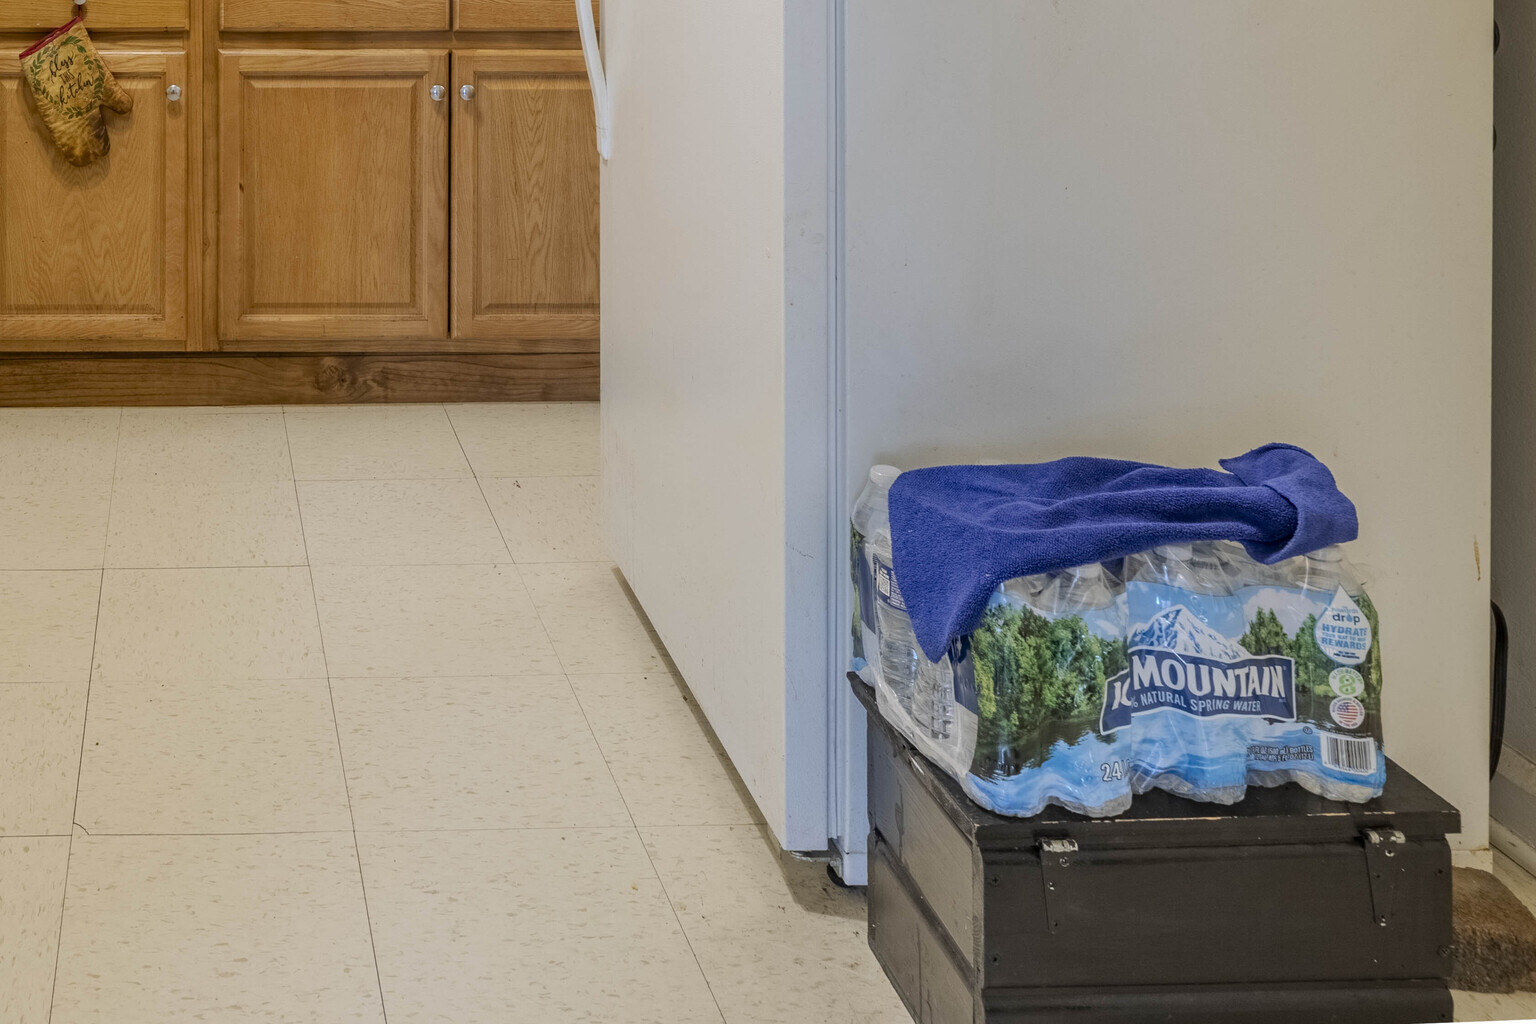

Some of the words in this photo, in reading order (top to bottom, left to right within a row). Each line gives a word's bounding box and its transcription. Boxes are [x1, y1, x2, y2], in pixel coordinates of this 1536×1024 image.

[49, 51, 75, 83] bless
[59, 69, 75, 84] THIS
[59, 72, 94, 106] kitchen
[1322, 623, 1368, 637] HYDRATE
[1321, 637, 1367, 651] REWARDS
[1131, 654, 1286, 698] MOUNTAIN
[1140, 690, 1187, 708] NATURAL
[1190, 698, 1230, 712] SPRING
[1233, 700, 1262, 712] WATER
[1289, 744, 1314, 754] BOTTLES
